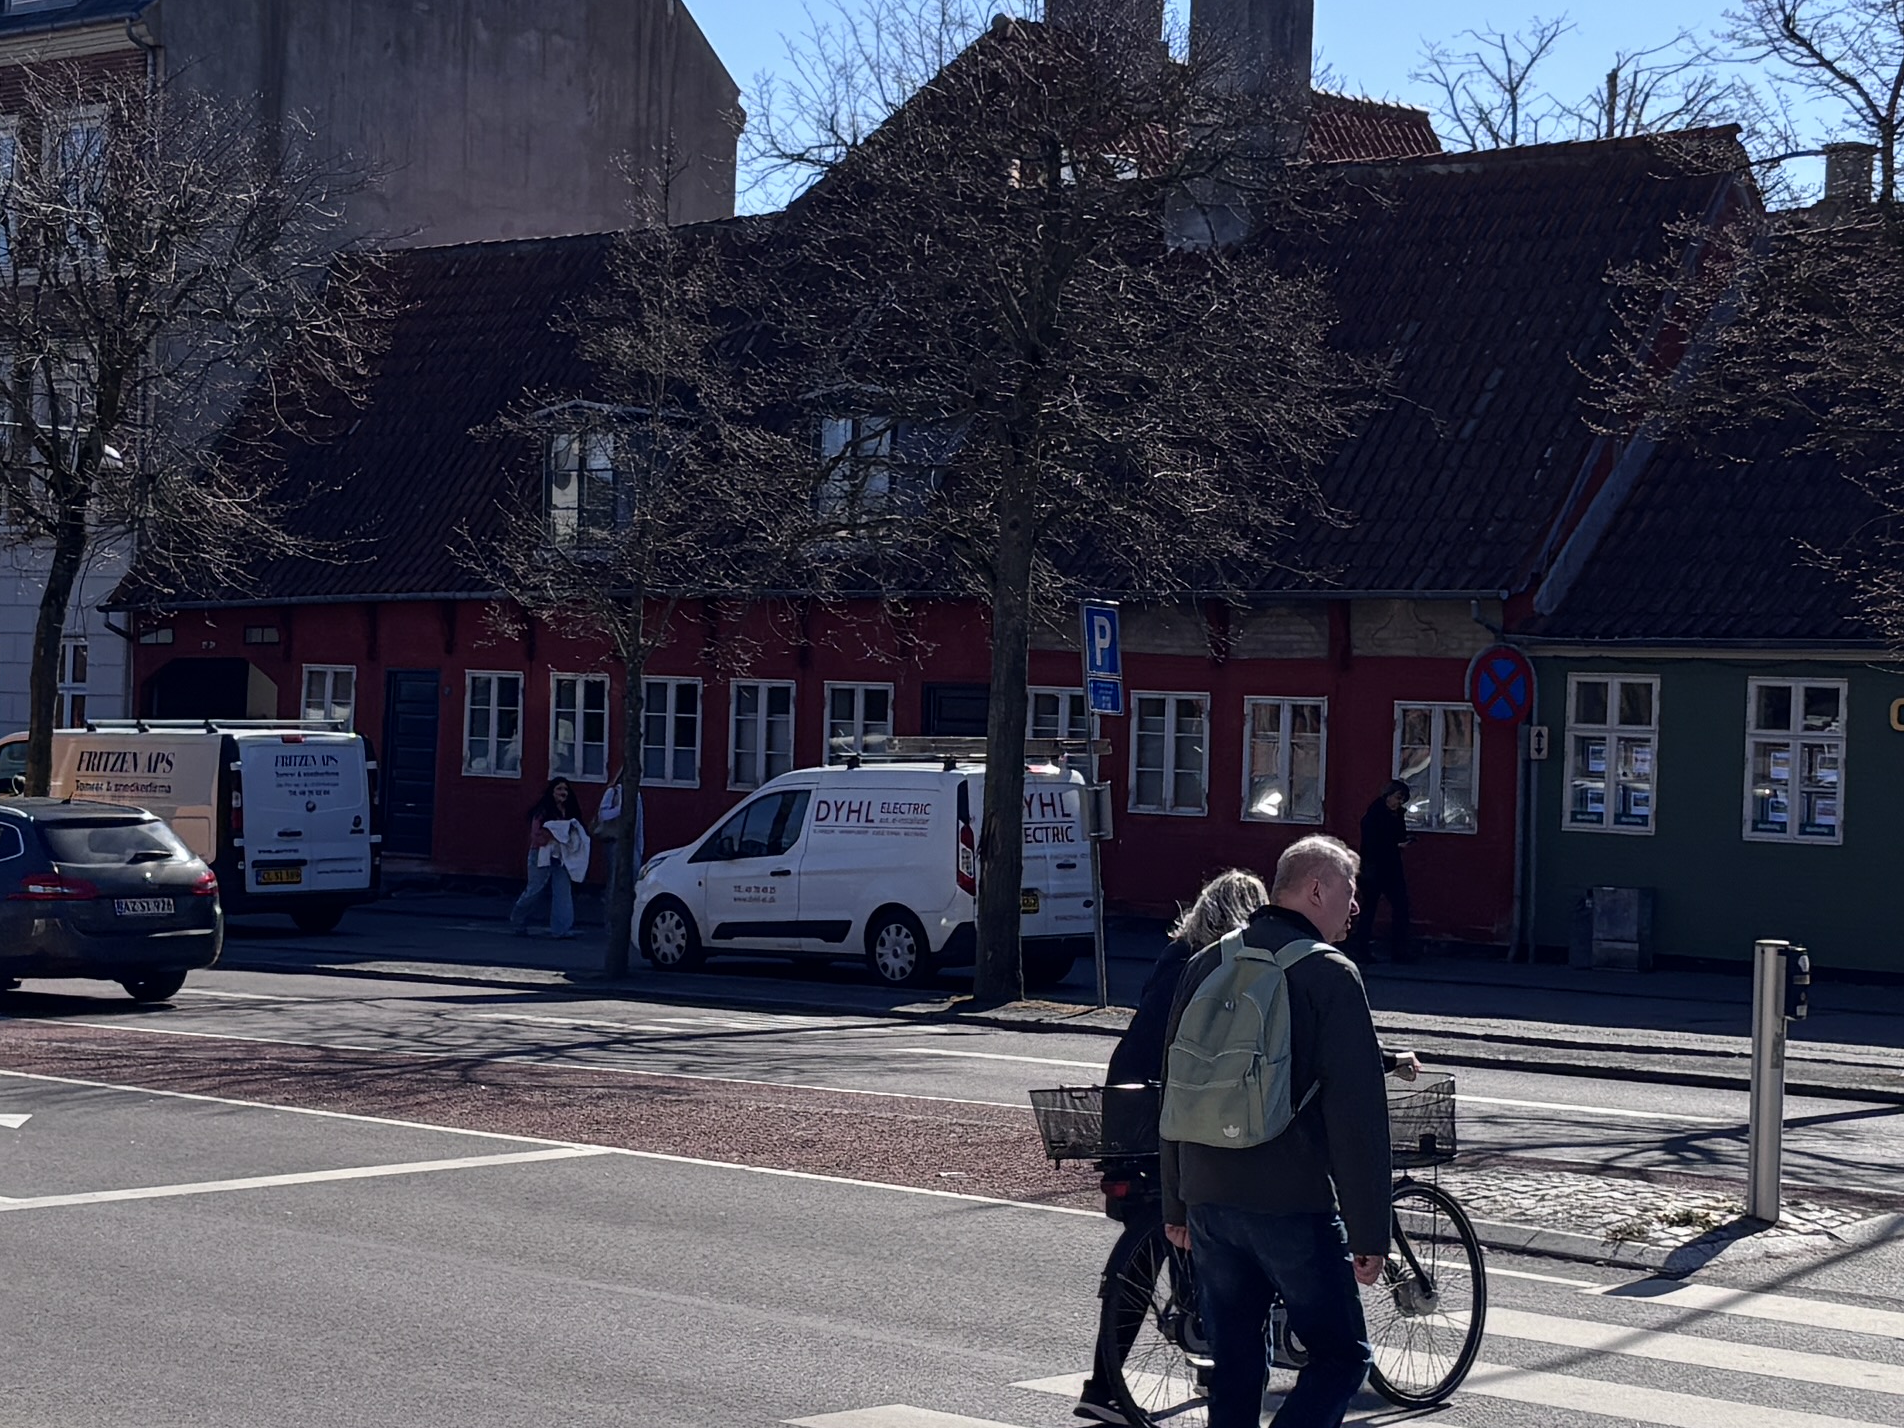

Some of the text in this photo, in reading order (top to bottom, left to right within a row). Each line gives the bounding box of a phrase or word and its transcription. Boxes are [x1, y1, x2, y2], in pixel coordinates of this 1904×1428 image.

[1093, 615, 1112, 666] P
[77, 751, 140, 773] FRITZEN
[274, 755, 317, 767] FRITZEN
[815, 800, 932, 823] DYHL ELECTRIC
[1024, 792, 1072, 818] YHL
[1024, 826, 1075, 843] ECTRIC
